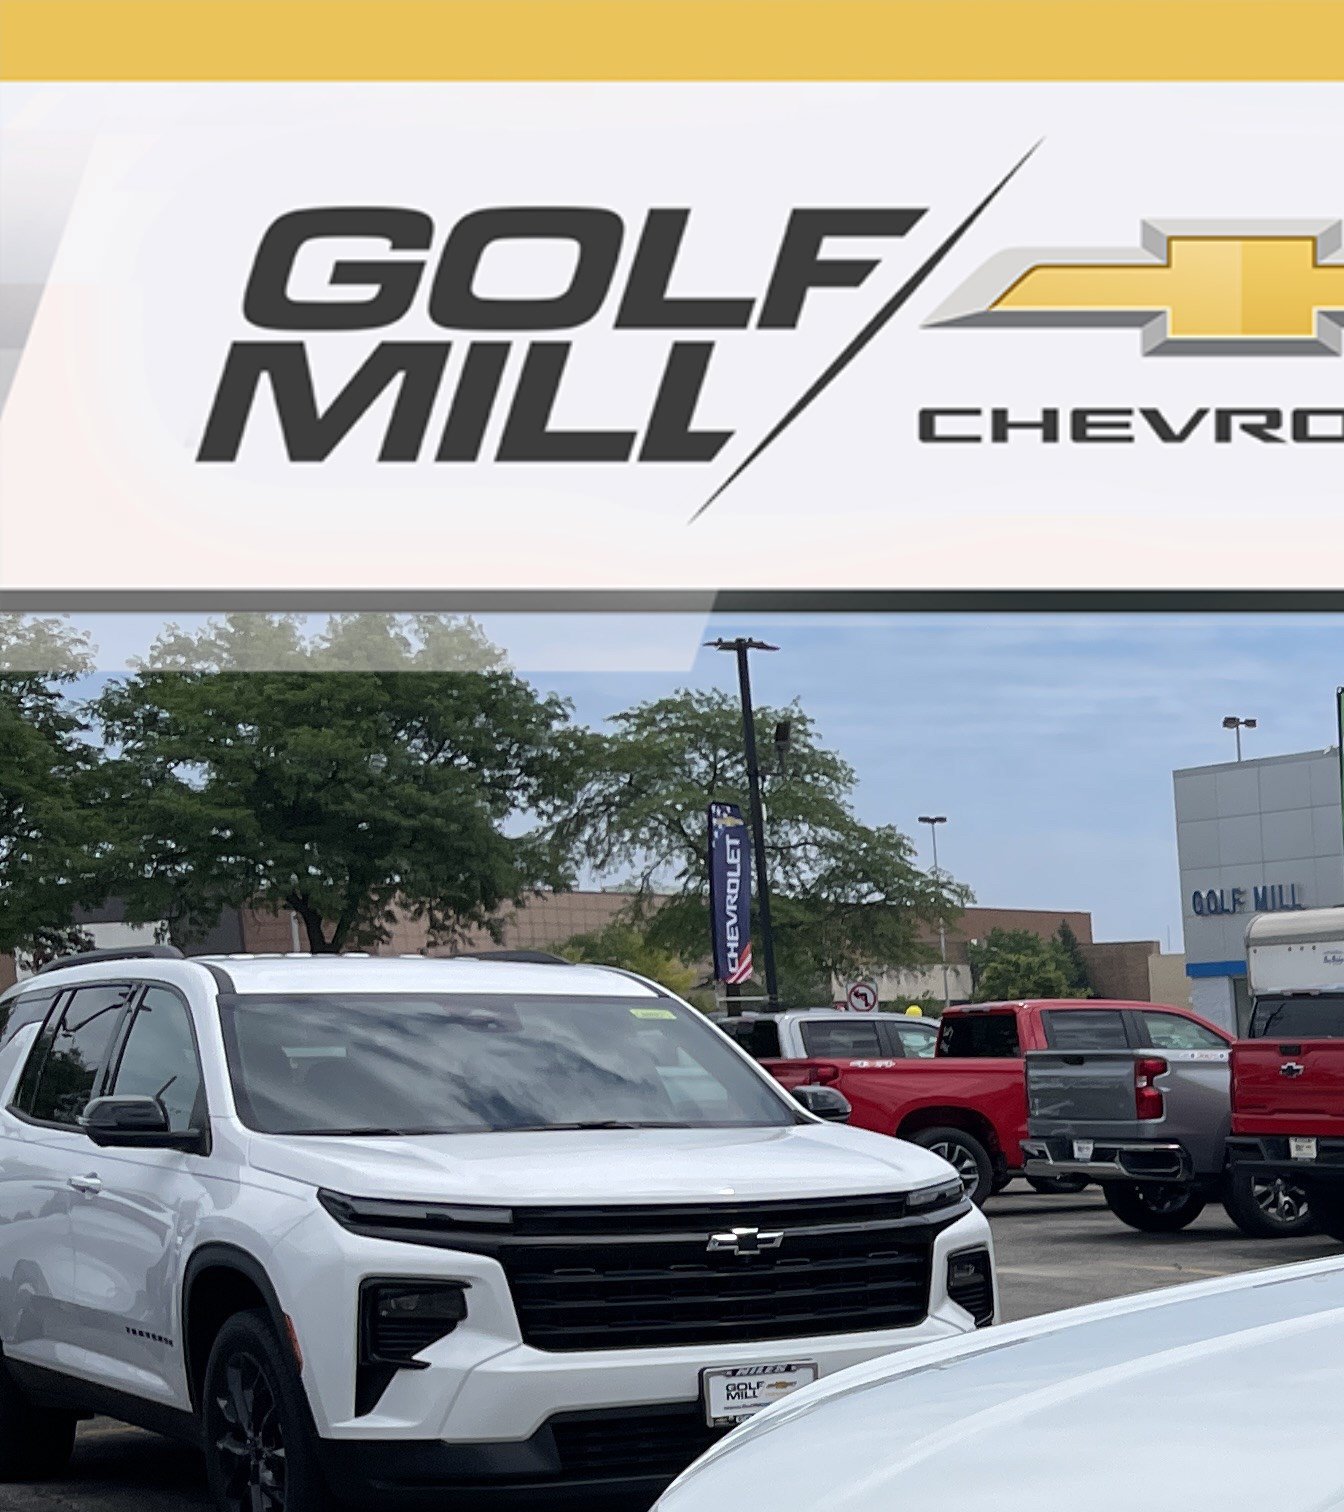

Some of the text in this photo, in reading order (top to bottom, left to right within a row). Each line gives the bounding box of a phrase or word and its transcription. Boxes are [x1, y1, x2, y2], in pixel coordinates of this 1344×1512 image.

[724, 833, 742, 974] CHEVROLET
[1191, 883, 1309, 917] GOLF MILL
[725, 1381, 765, 1391] GOLF
[726, 1390, 758, 1401] MILL
